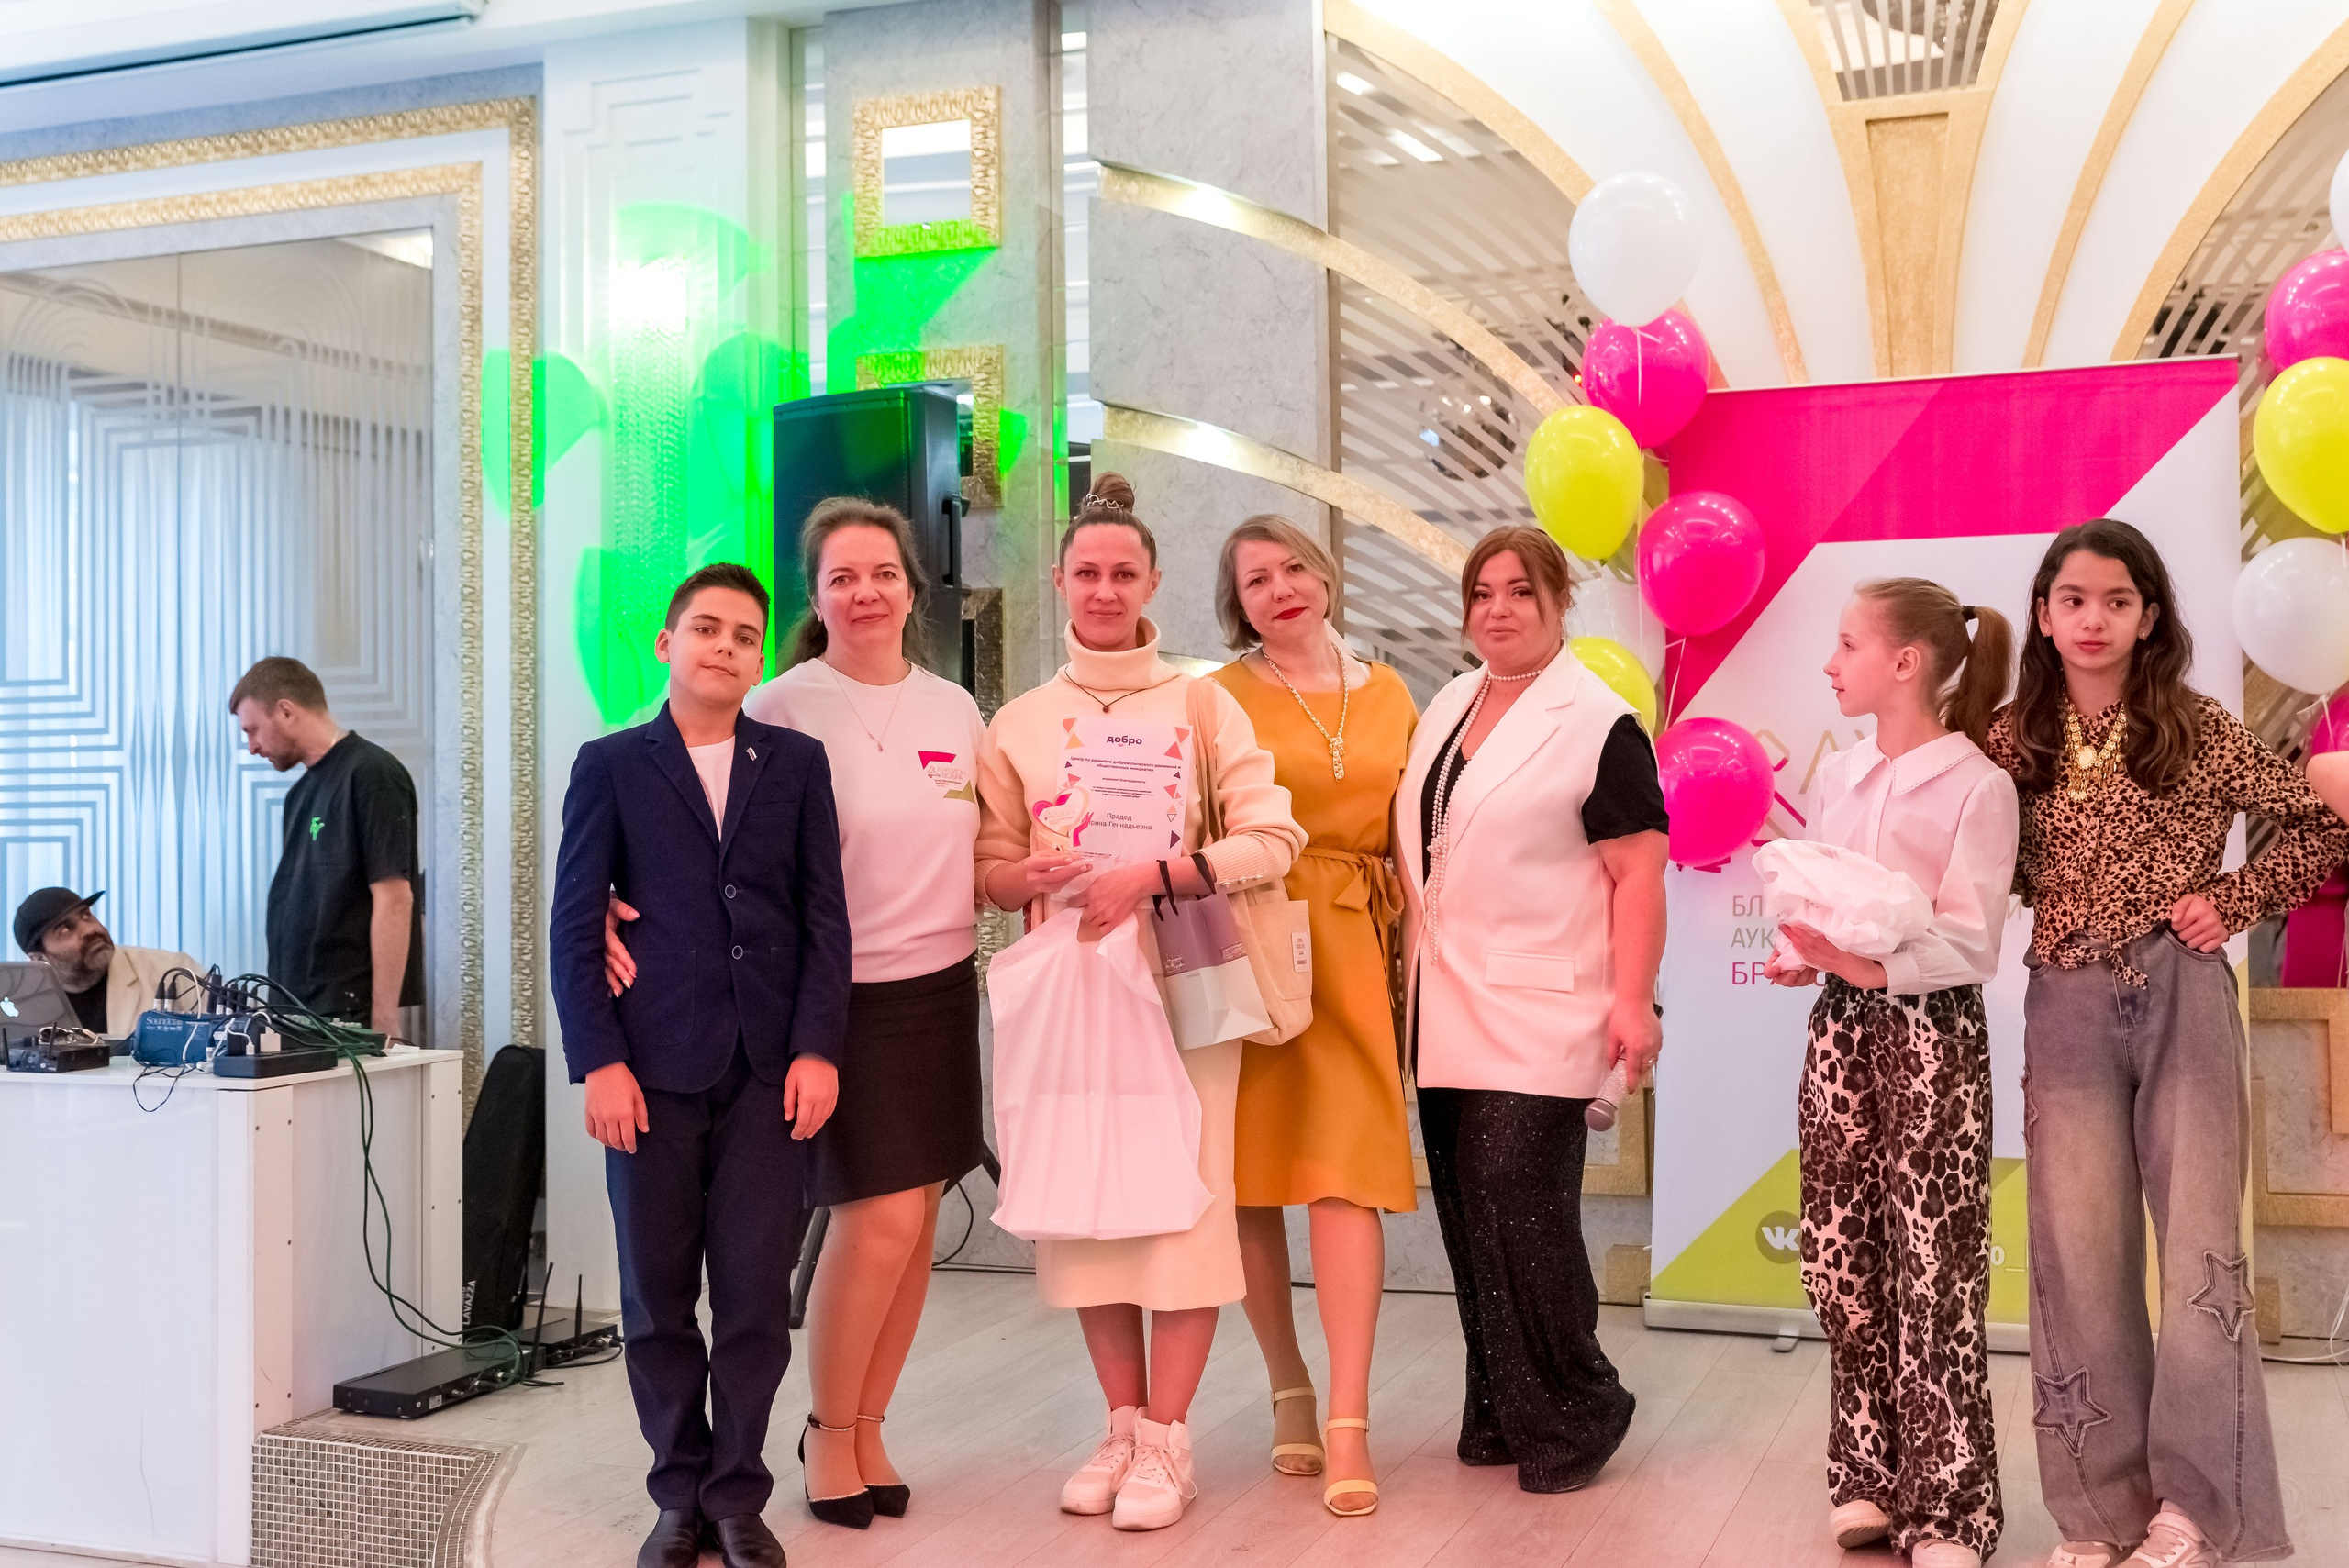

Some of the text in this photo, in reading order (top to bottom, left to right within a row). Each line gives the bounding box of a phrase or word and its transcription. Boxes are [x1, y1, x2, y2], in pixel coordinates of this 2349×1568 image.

[1107, 735, 1142, 746] добро
[1107, 812, 1132, 821] Прадед
[1108, 821, 1152, 830] Геннадьевна
[462, 1280, 476, 1325] LAVAZZA
